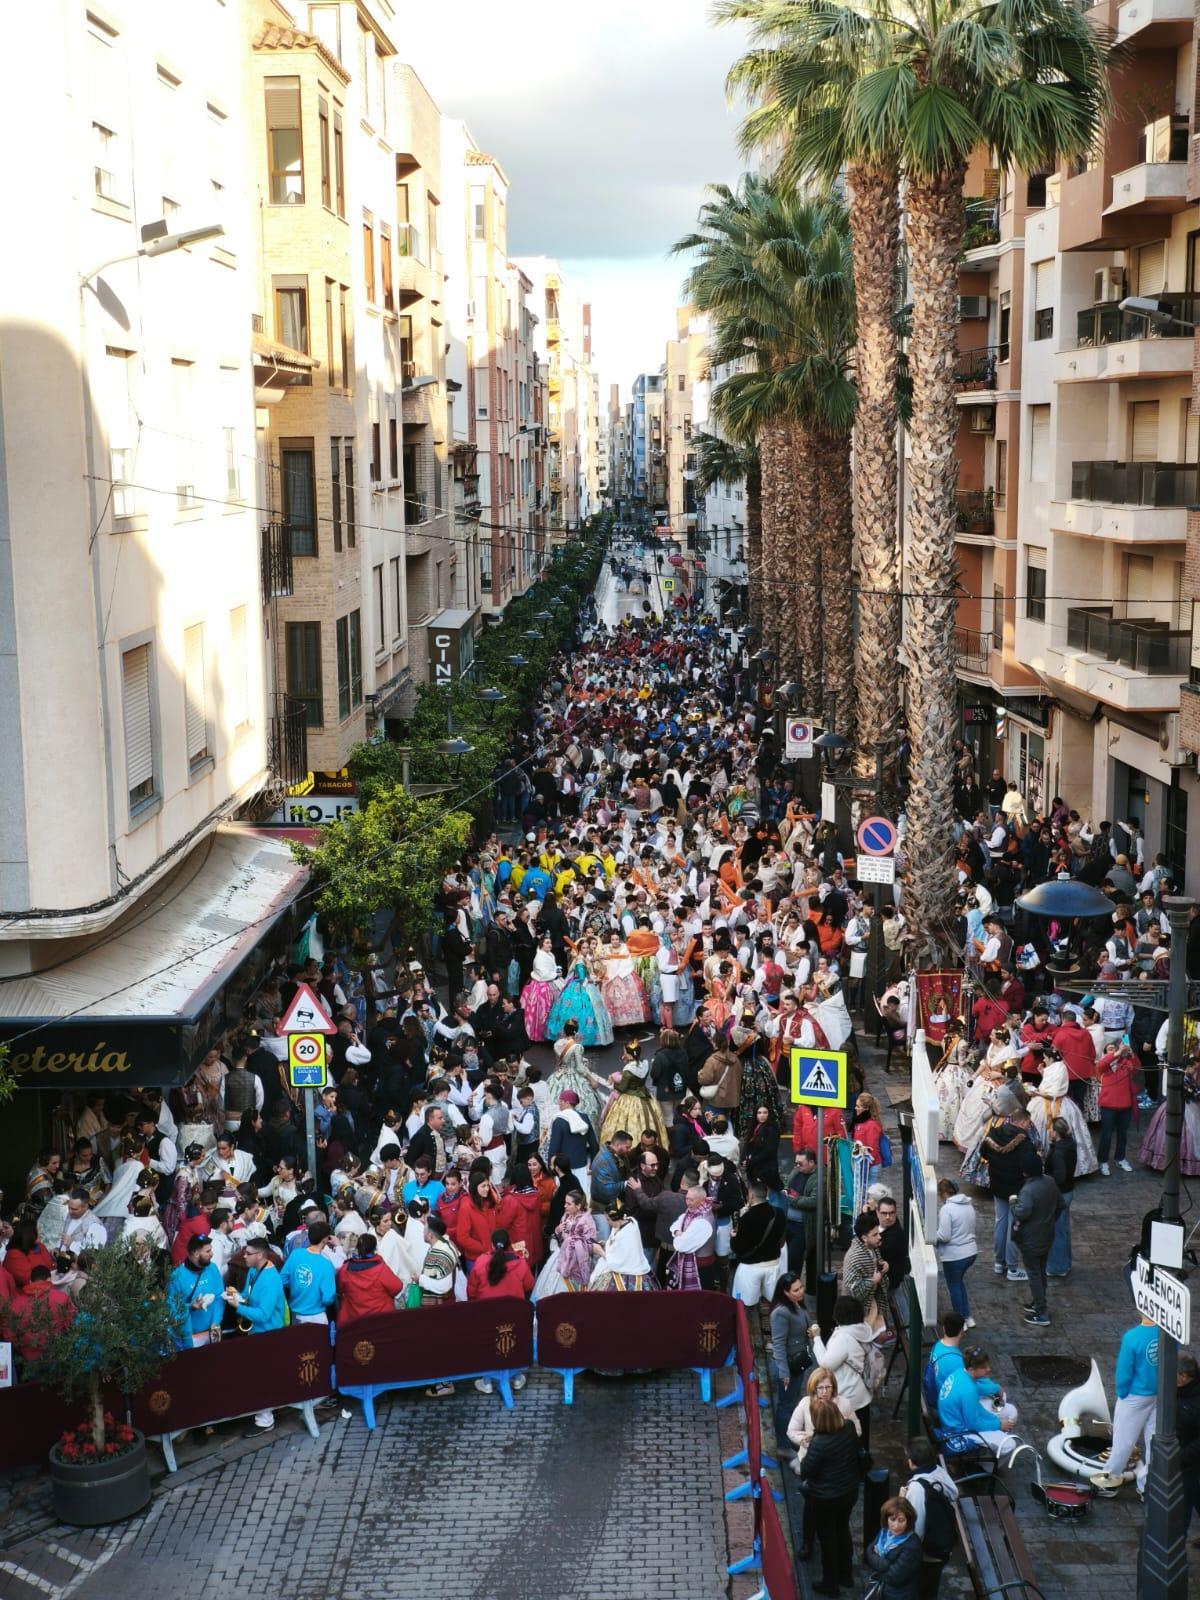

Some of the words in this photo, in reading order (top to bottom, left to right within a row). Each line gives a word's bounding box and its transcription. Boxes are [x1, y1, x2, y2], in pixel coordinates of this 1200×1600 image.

[8, 1041, 131, 1073] etería
[299, 1044, 315, 1055] 20
[1137, 1289, 1183, 1340] CASTELLÓ
